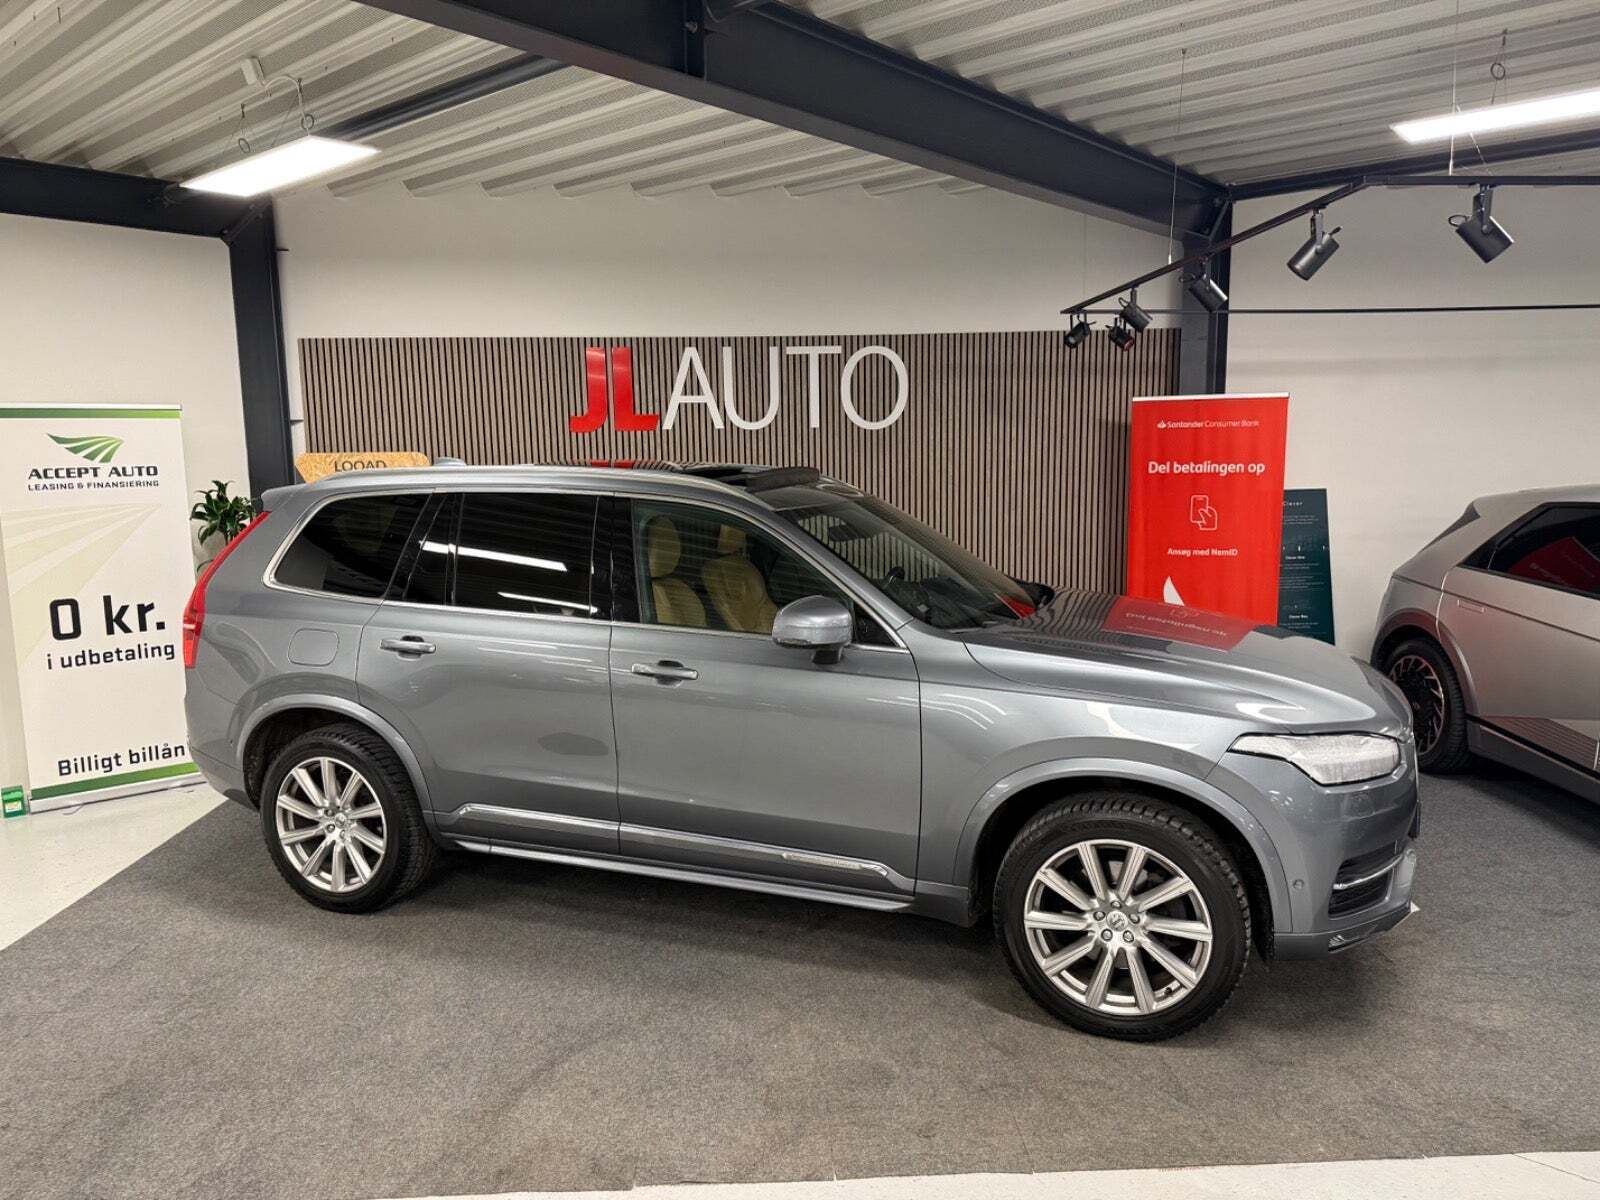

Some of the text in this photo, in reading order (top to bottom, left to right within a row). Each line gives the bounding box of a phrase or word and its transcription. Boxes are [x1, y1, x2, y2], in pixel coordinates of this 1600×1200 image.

[569, 345, 909, 433] JL AUTO
[1167, 419, 1259, 429] Santander Consumer Bank
[28, 465, 159, 480] ACCEPT AUTO
[1148, 460, 1265, 476] Del betalingen op
[28, 482, 75, 492] LEASING
[87, 480, 160, 489] FINANSIERING
[1167, 548, 1239, 557] Ansøg med NemID
[49, 594, 166, 641] 0 kr.
[46, 643, 176, 670] i udbetaling
[57, 742, 186, 776] Billigt billån
